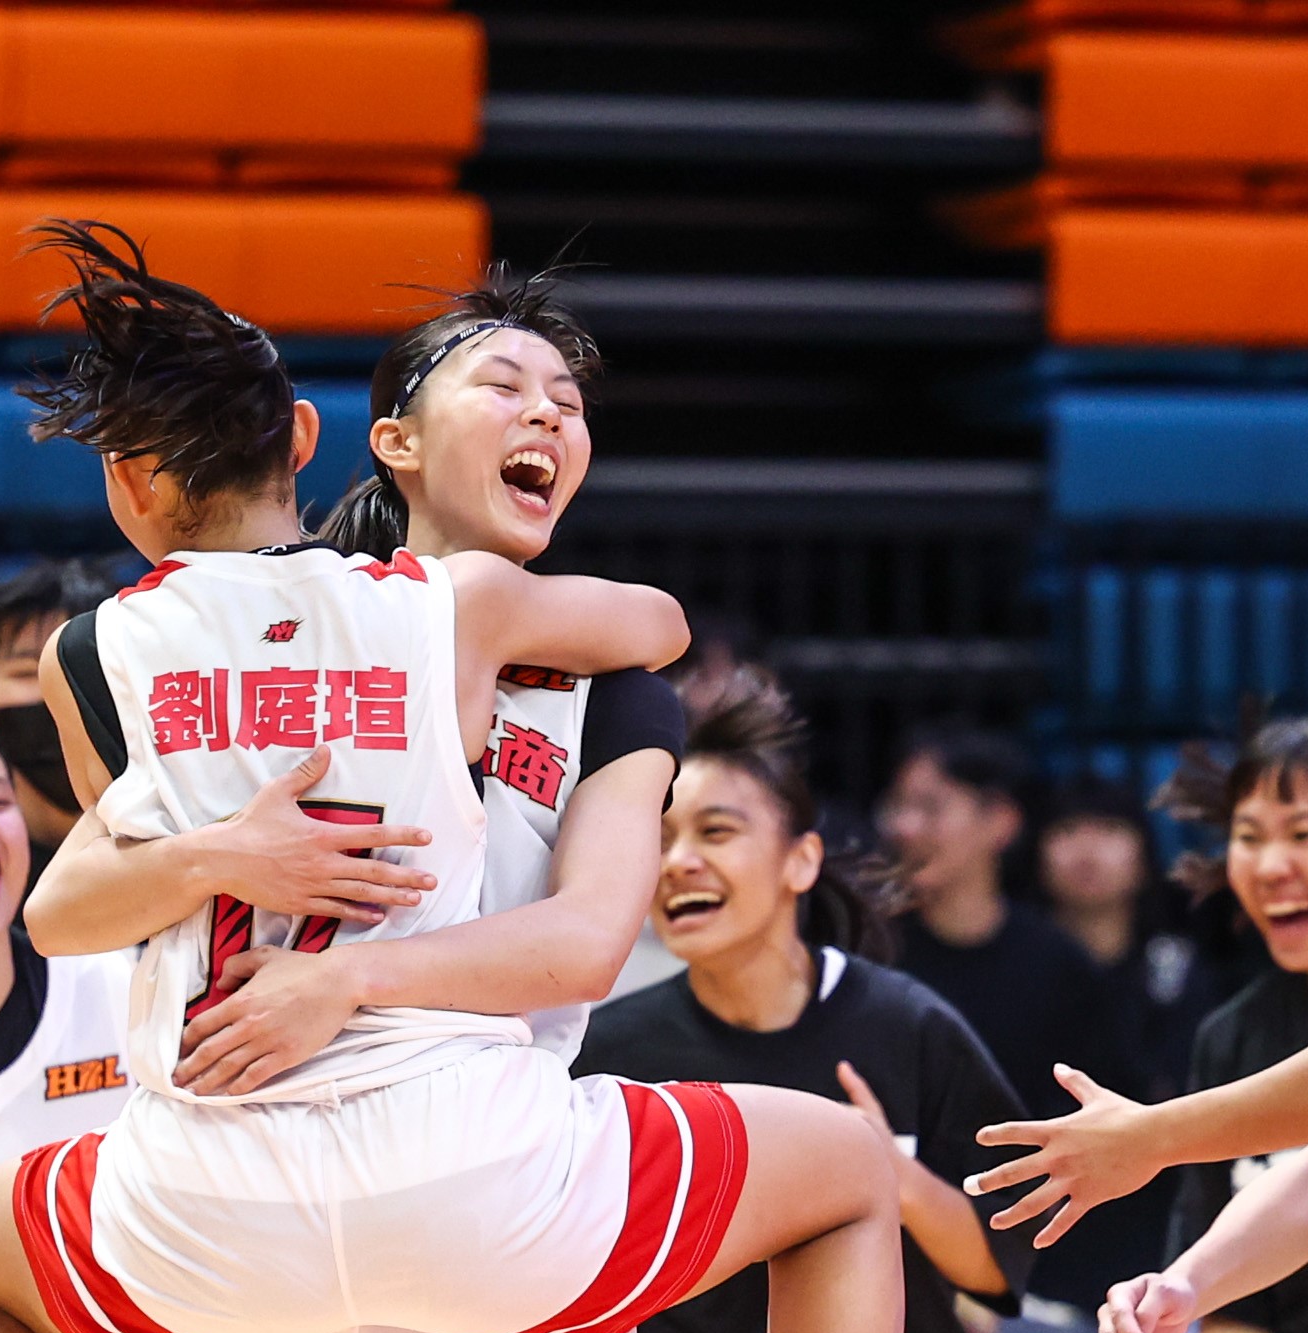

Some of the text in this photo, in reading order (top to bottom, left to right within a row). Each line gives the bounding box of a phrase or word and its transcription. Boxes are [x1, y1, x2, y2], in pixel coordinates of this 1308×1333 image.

[460, 325, 479, 339] NIKE
[430, 345, 448, 364] NIKE
[405, 371, 421, 395] NIKE
[148, 666, 408, 756] 劉庭瑄
[482, 714, 569, 812] 商
